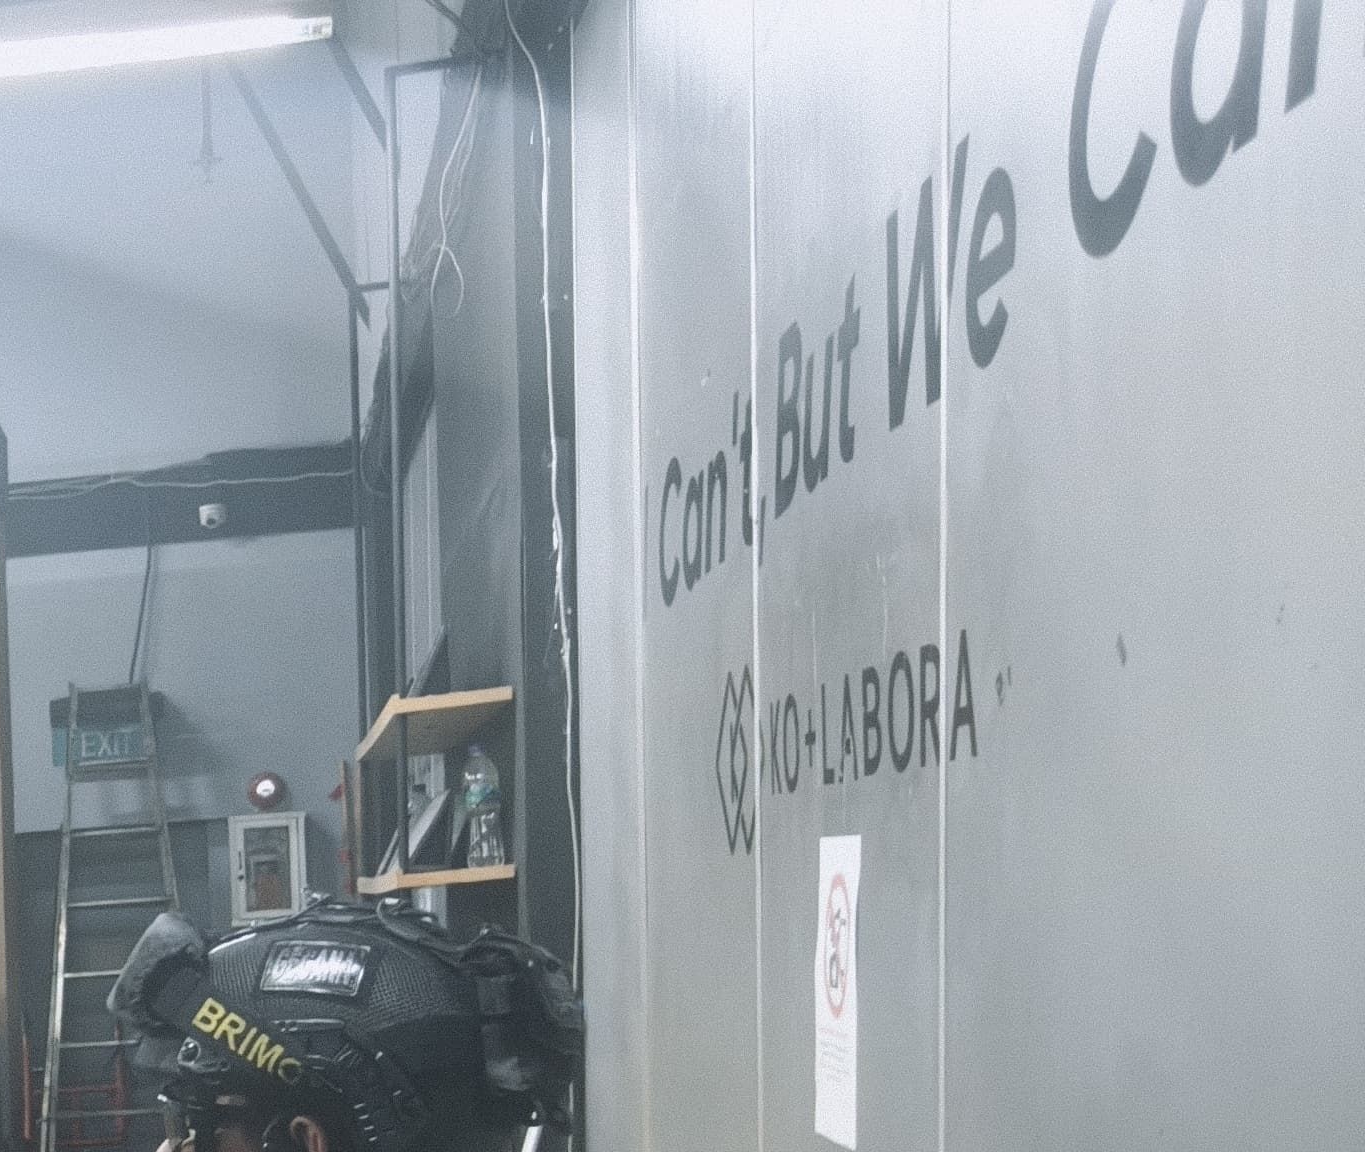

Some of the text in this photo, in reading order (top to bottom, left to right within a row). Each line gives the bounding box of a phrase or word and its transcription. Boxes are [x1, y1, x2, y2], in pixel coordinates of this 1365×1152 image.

[774, 271, 860, 520] But
[885, 132, 1017, 431] We
[80, 727, 134, 758] EXIT
[770, 629, 978, 796] KO+LABORA
